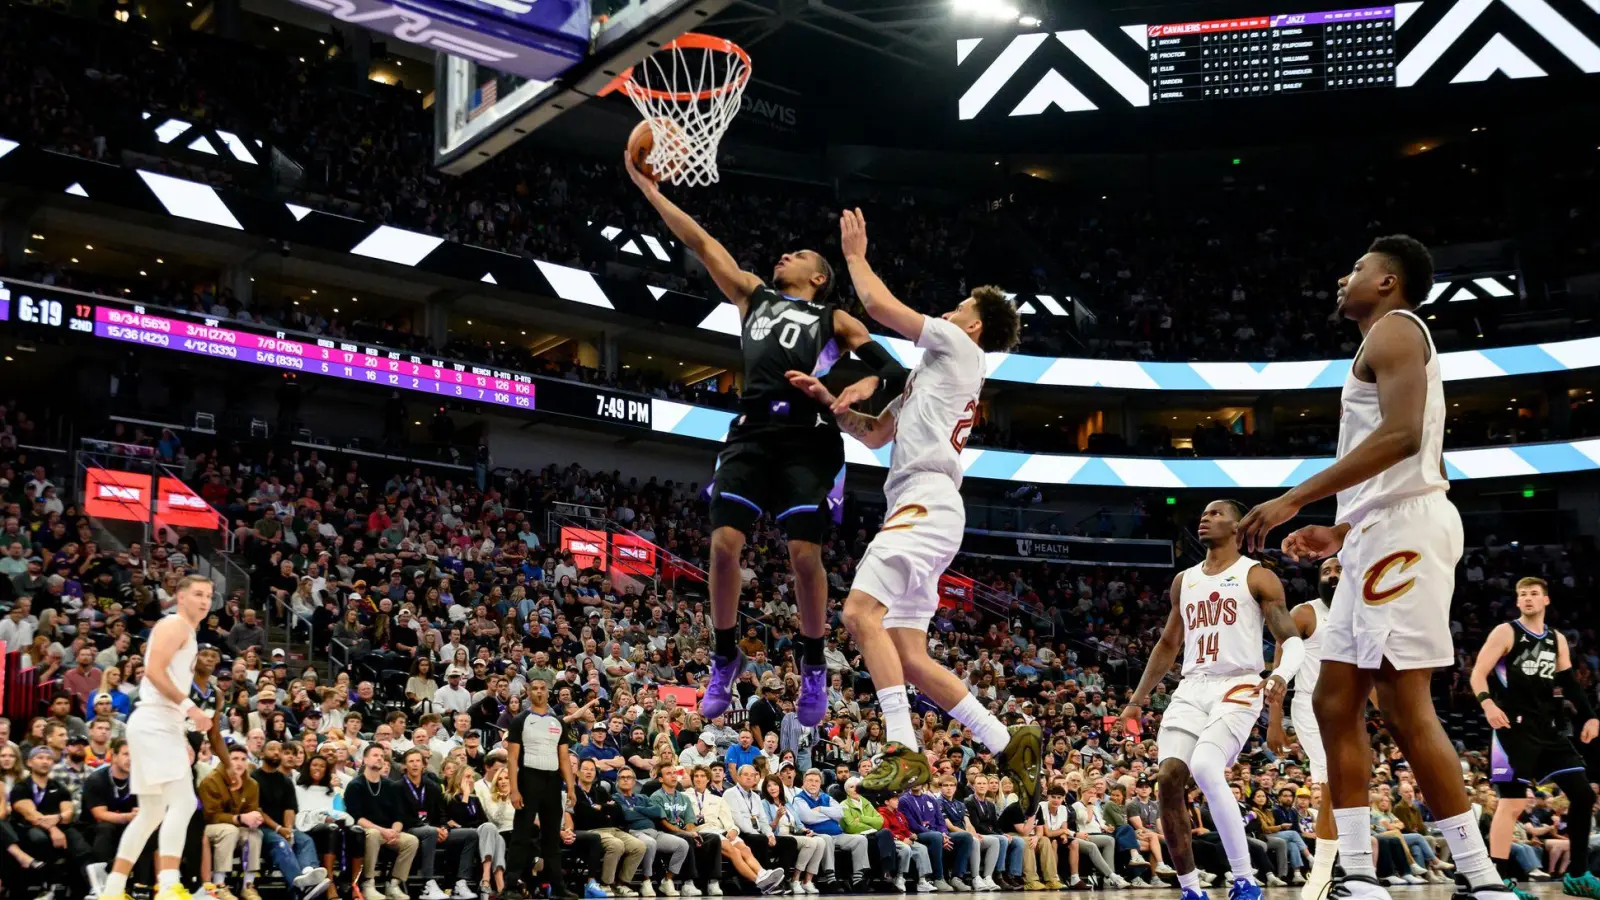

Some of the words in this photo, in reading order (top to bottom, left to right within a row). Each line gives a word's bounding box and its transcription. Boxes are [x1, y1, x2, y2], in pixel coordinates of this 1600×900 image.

[1163, 24, 1201, 35] CAVALIERS
[1286, 15, 1305, 24] JAZZ
[1272, 43, 1280, 51] 22
[18, 296, 62, 327] 6:19
[75, 305, 91, 318] 17
[69, 318, 93, 333] 2ND
[779, 322, 802, 349] 0
[135, 306, 145, 314] FG
[389, 352, 400, 360] AST
[411, 356, 421, 364] STL
[432, 360, 443, 368] BLK
[472, 367, 491, 377] BENCH
[108, 326, 138, 339] 15/36
[184, 340, 207, 351] 4/12
[257, 352, 277, 363] 5/6
[321, 363, 329, 373] 5
[344, 367, 353, 377] 11
[366, 371, 377, 381] 16
[388, 375, 399, 385] 12
[412, 379, 419, 388] 2
[435, 383, 440, 391] 1
[455, 386, 462, 395] 3
[478, 390, 485, 399] 7
[495, 393, 510, 404] 106
[516, 397, 530, 407] 126
[187, 325, 207, 337] 3/11
[259, 338, 275, 349] 7/9
[322, 349, 329, 359] 3
[344, 354, 354, 363] 17
[366, 357, 378, 368] 20
[389, 362, 399, 372] 12
[412, 365, 419, 375] 2
[434, 370, 441, 379] 3
[456, 374, 462, 383] 3
[476, 376, 488, 388] 13
[496, 381, 509, 395] 126
[514, 383, 530, 395] 106
[596, 394, 625, 420] 7:49
[628, 400, 649, 424] PM
[1034, 543, 1070, 554] HEALTH
[1185, 597, 1238, 631] CAVS
[1196, 631, 1220, 665] 14
[1540, 661, 1556, 680] 22
